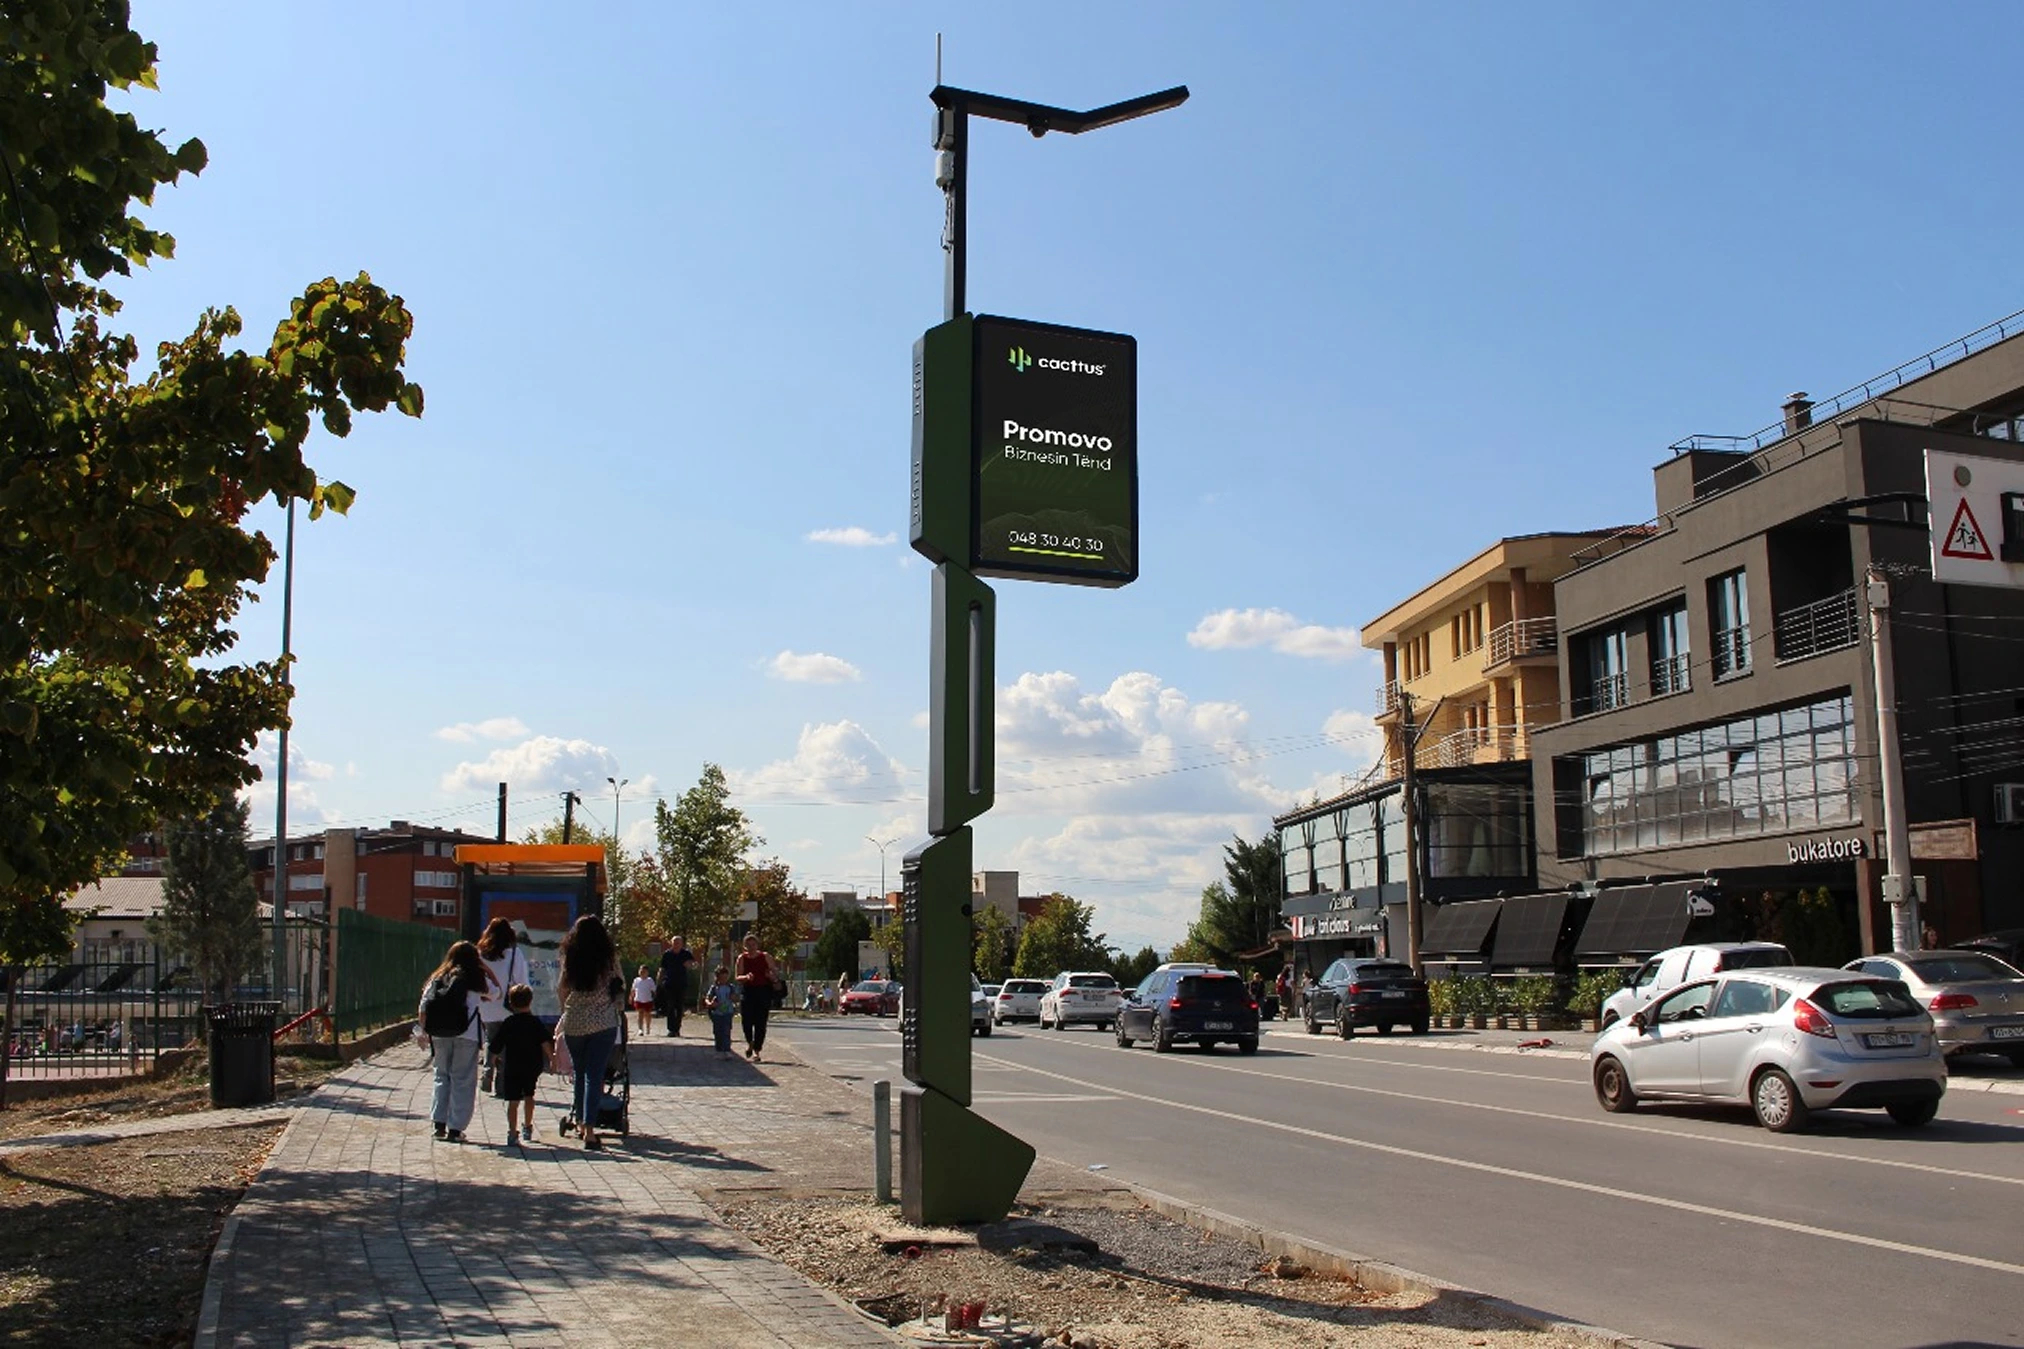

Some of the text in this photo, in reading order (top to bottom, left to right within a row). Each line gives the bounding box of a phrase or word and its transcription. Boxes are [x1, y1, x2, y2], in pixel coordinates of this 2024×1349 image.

[1038, 358, 1104, 376] cacttus
[1003, 420, 1112, 452] Promovo
[1004, 445, 1111, 471] Biznesin Tënd
[1008, 530, 1103, 551] 048 30 40 30
[1787, 836, 1862, 864] bukatore
